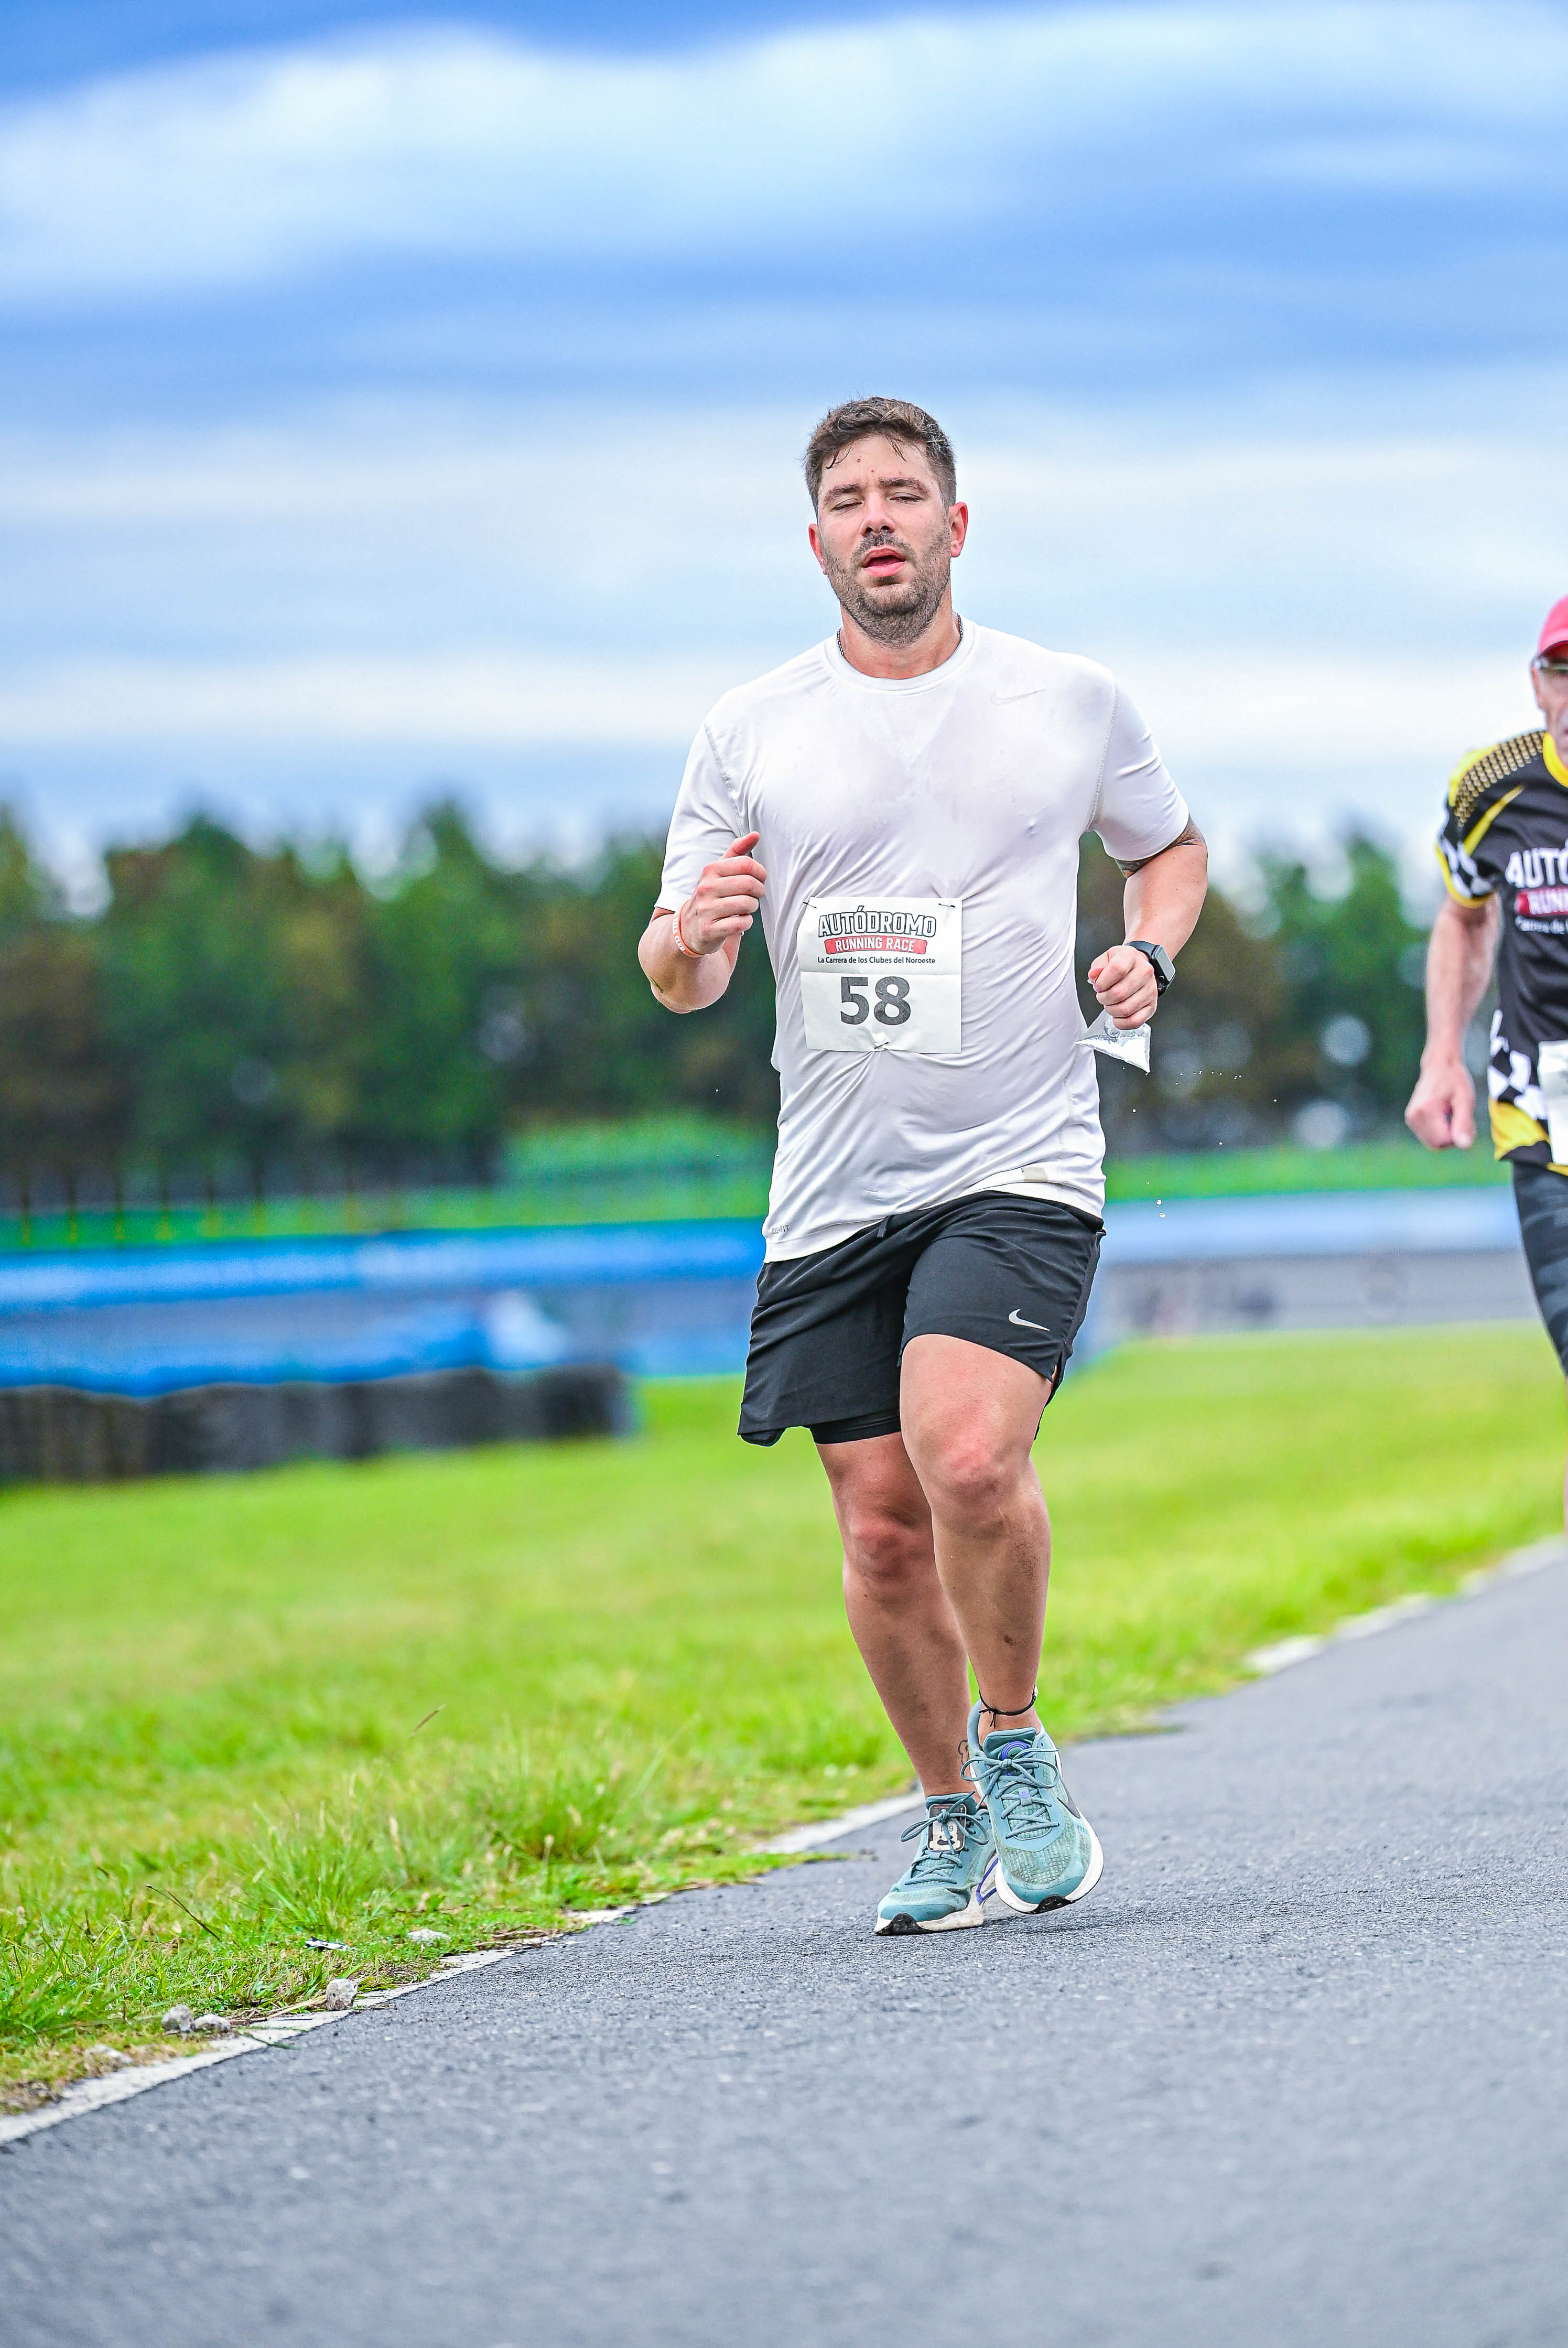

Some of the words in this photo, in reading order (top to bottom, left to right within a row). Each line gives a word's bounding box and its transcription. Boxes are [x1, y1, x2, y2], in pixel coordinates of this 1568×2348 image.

[818, 906, 936, 938] AUTÓDROMO
[835, 937, 883, 952] RUNNING
[886, 937, 915, 952] RACE
[840, 976, 911, 1026] 58
